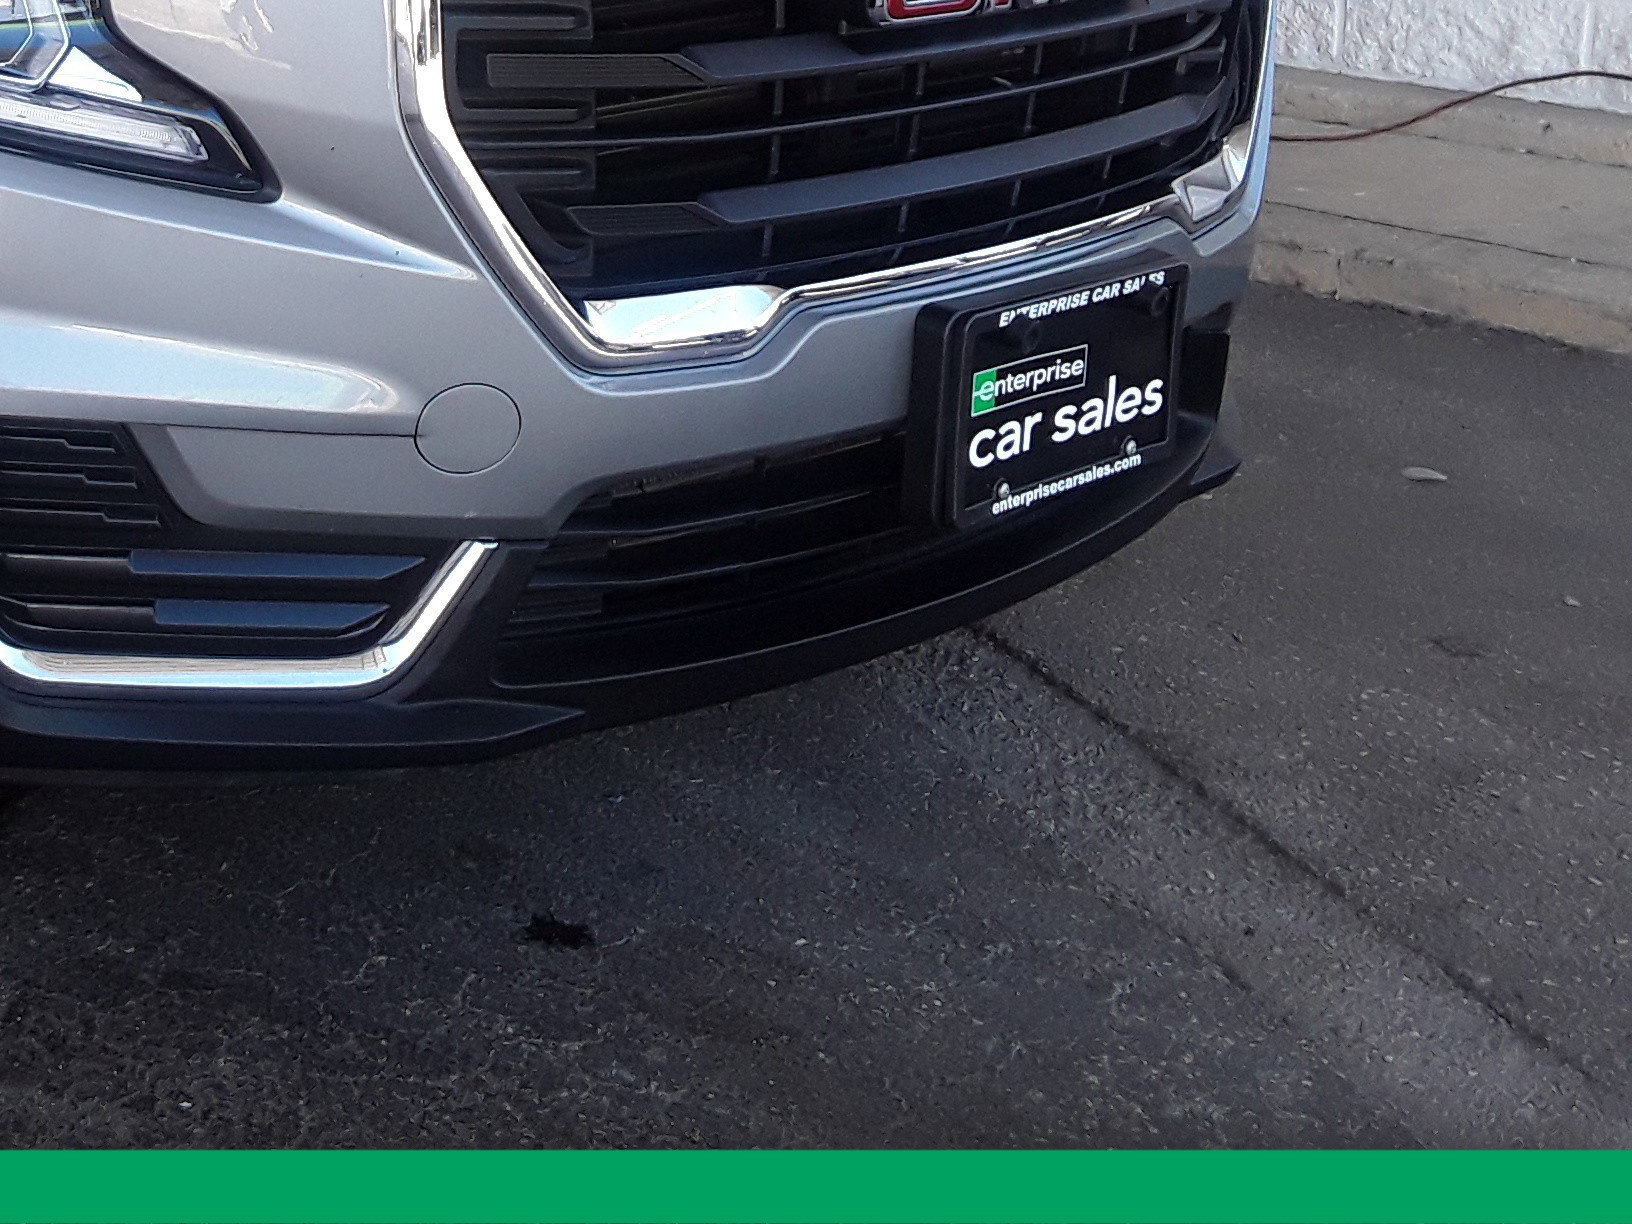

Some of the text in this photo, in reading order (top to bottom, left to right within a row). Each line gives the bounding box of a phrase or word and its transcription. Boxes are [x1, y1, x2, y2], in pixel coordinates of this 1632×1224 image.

[1092, 282, 1122, 304] CAR
[975, 359, 1084, 401] enterprise
[969, 375, 1164, 468] car sales
[991, 453, 1142, 516] enterprisecarsales.com
